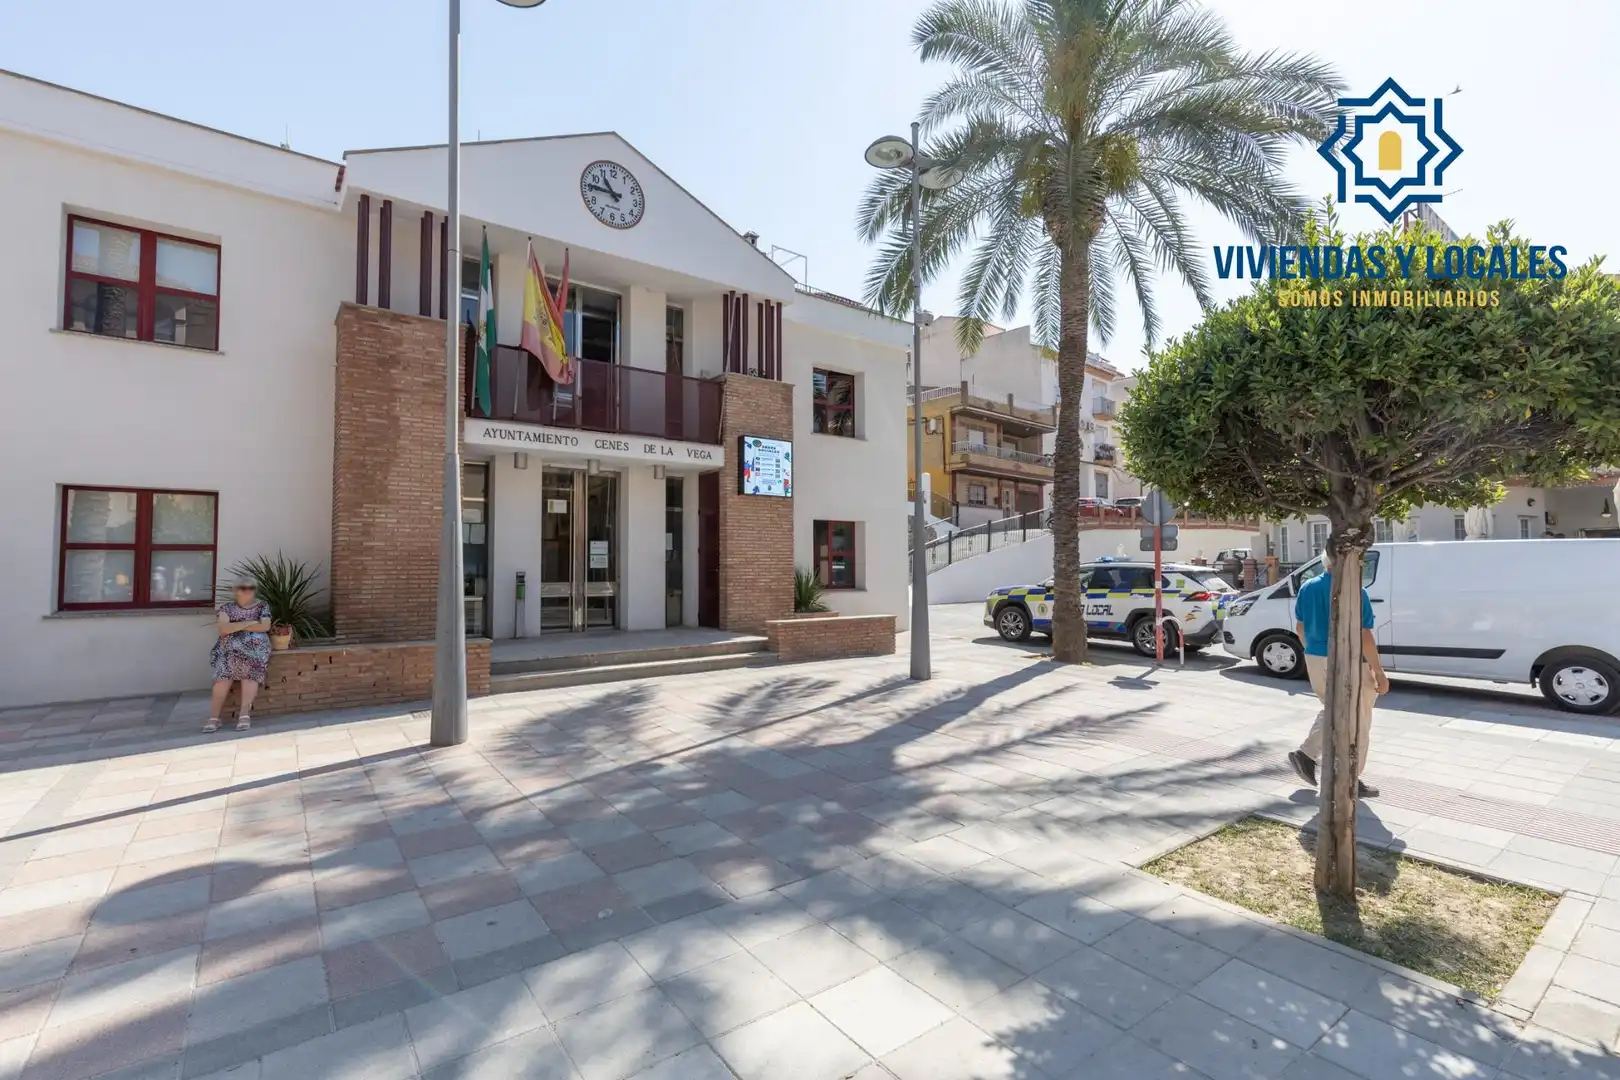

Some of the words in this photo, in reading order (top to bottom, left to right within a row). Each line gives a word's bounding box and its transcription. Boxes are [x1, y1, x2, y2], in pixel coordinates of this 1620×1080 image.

[600, 169, 606, 177] 11
[609, 169, 618, 179] 12
[592, 174, 600, 184] 10
[622, 176, 626, 184] 1
[630, 186, 636, 195] 2
[591, 196, 596, 205] 8
[633, 200, 638, 208] 3
[599, 207, 605, 215] 7
[628, 209, 634, 217] 4
[609, 212, 615, 221] 6
[620, 214, 626, 222] 5
[483, 428, 579, 447] AYUNTAMIENTO
[594, 439, 630, 452] CENES
[643, 443, 657, 454] DE
[660, 445, 674, 456] LA
[686, 448, 713, 460] VEGA
[1086, 604, 1114, 616] LOCAL
